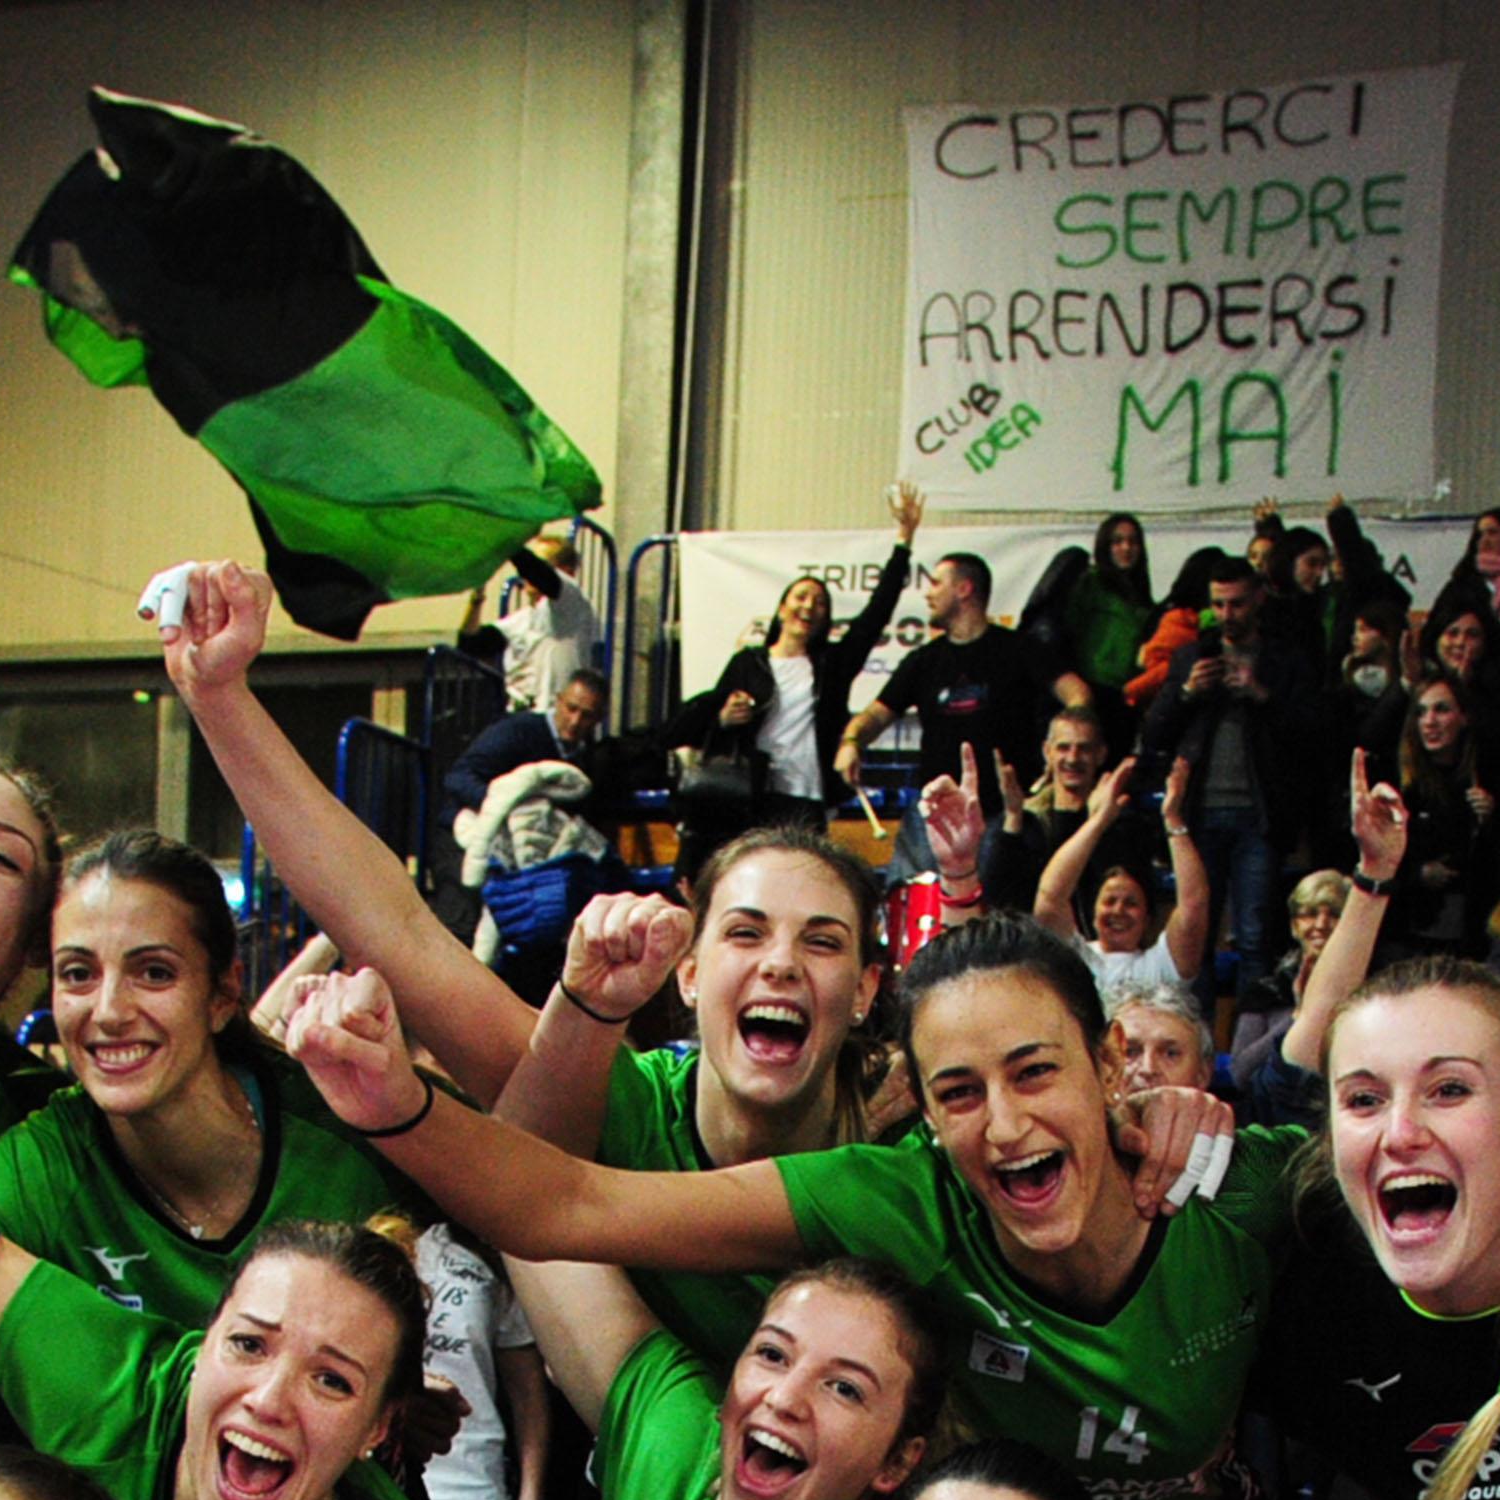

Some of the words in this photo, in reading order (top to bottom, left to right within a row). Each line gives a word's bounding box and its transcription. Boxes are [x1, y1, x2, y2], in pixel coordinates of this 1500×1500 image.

[934, 82, 1364, 179] CREDERCI
[1054, 175, 1406, 269] SEMPRE
[915, 381, 1002, 455] CLUB
[964, 402, 1043, 474] IDEA
[1075, 1405, 1151, 1464] 14
